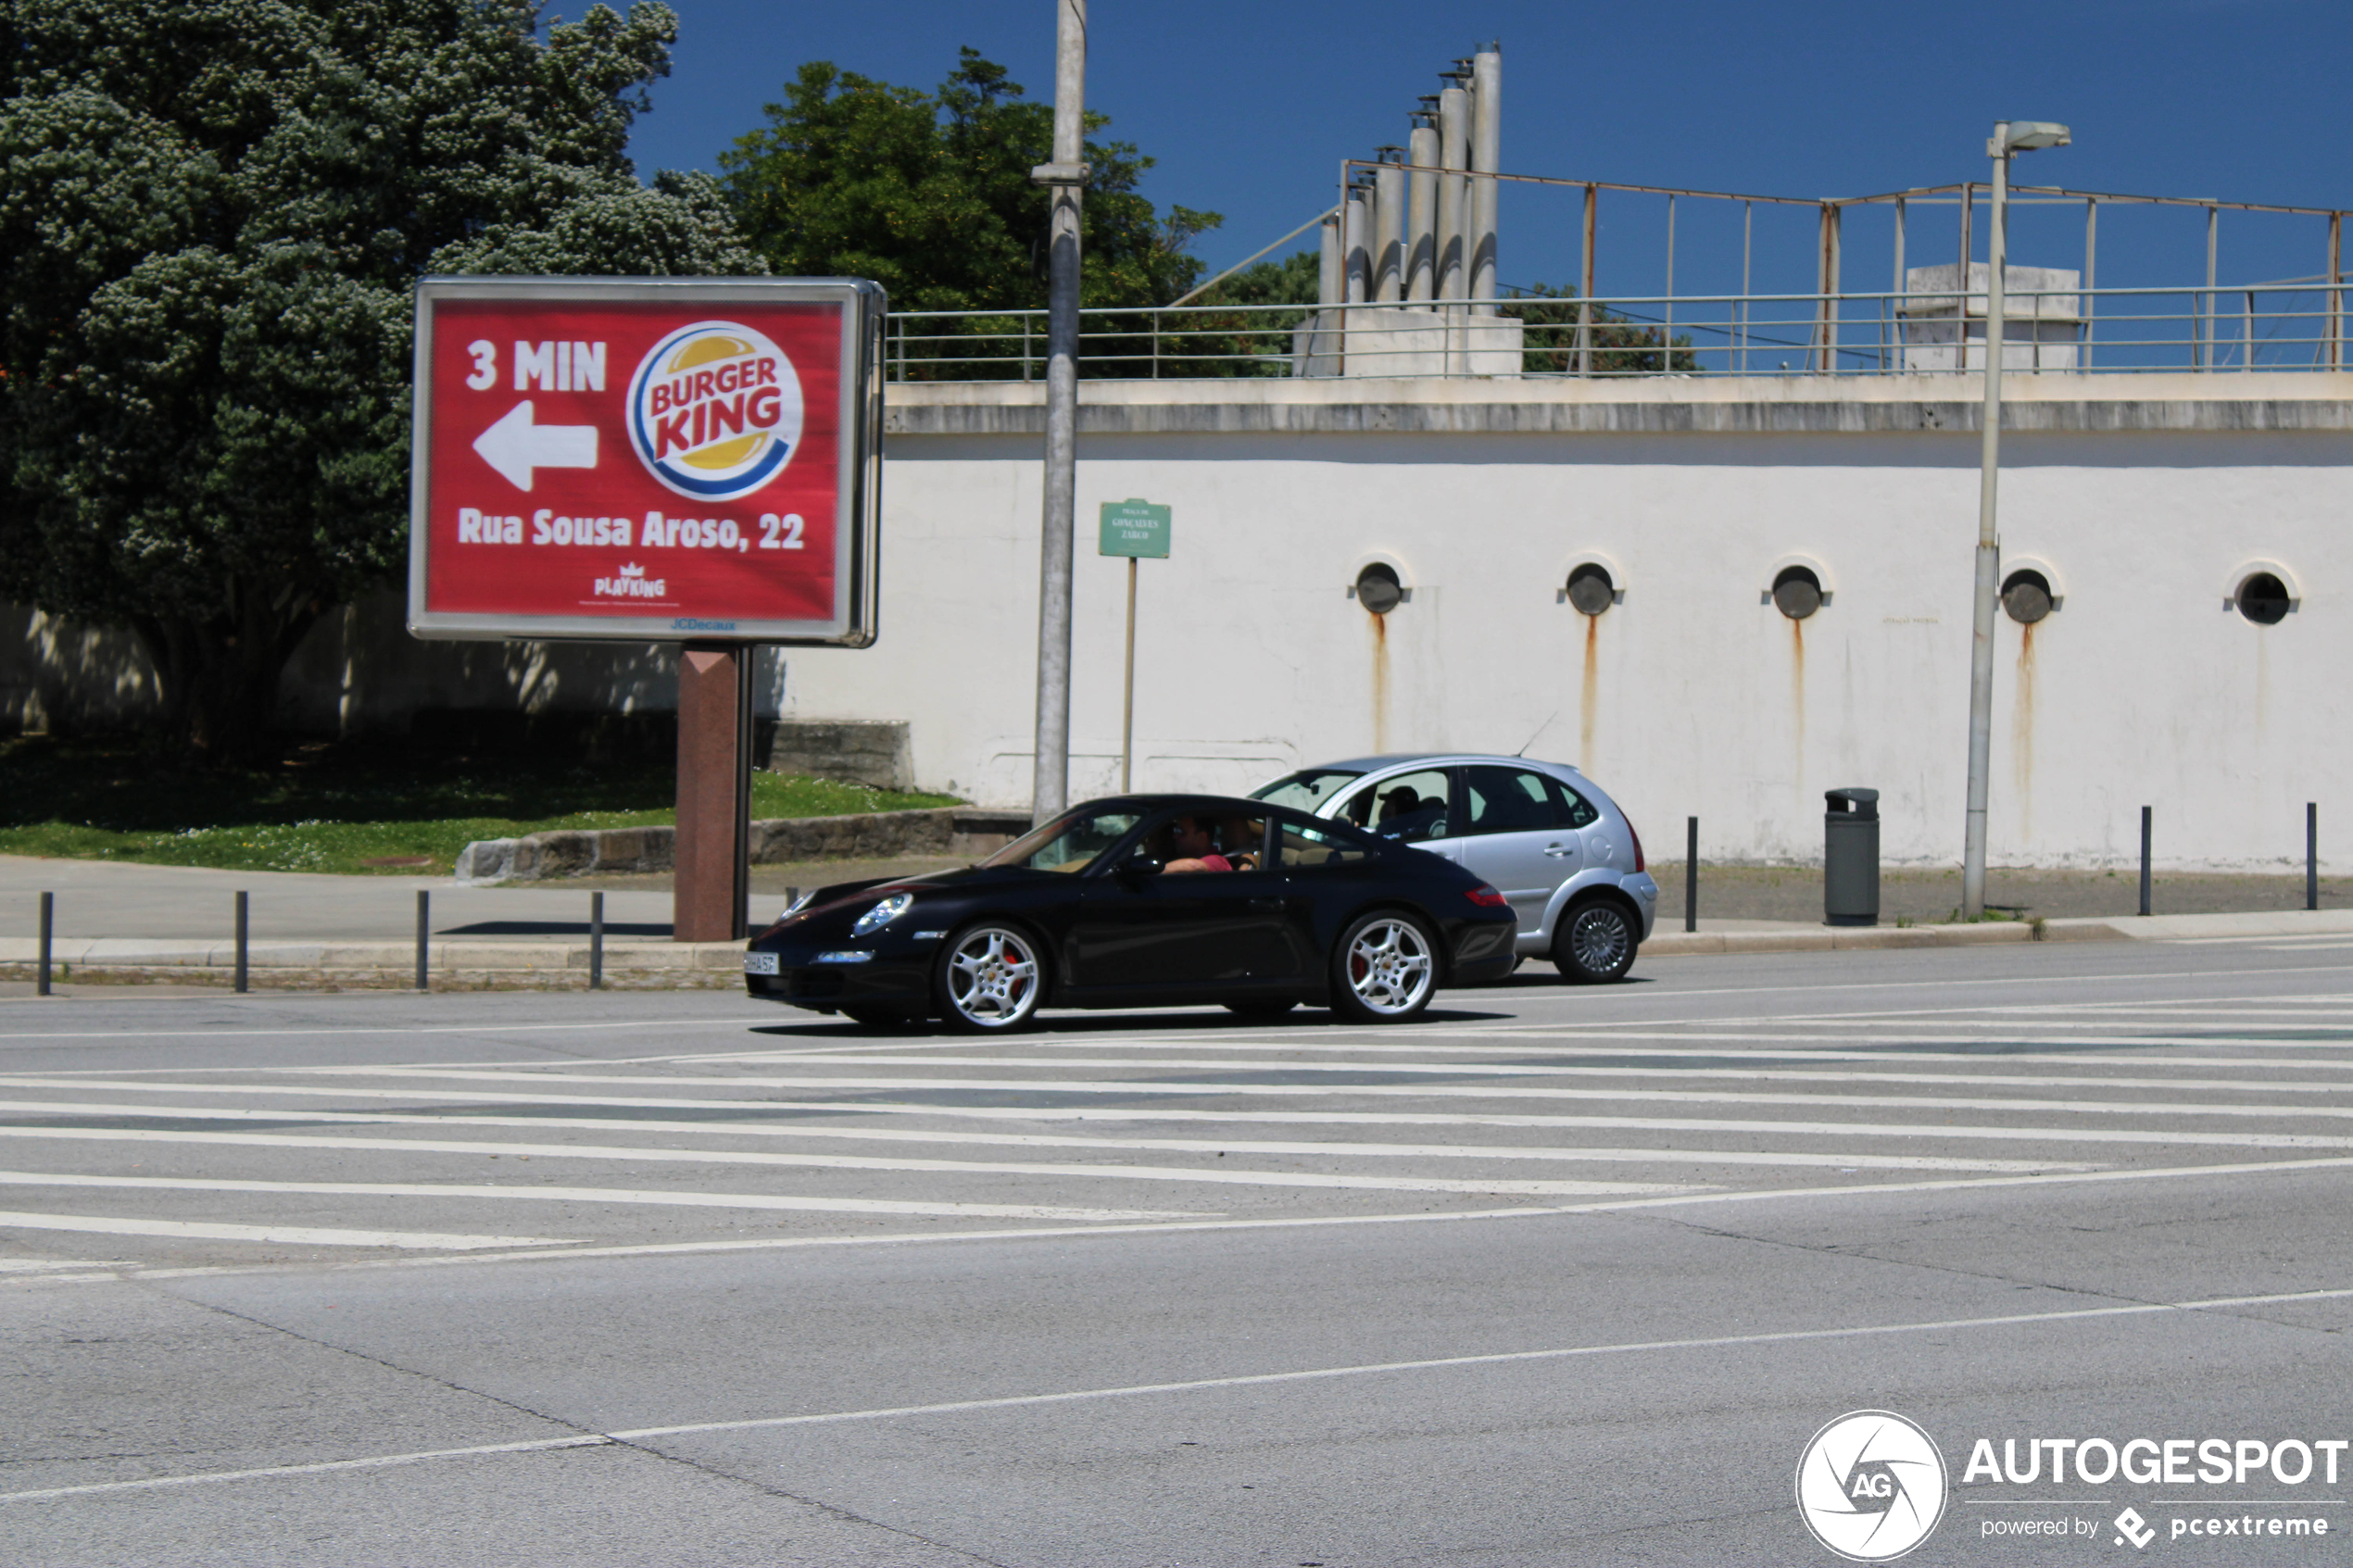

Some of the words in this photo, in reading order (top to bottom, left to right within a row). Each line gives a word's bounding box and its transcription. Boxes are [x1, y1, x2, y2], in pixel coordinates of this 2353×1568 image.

[466, 339, 497, 391] 3
[514, 340, 607, 392] MIN
[650, 357, 777, 418] BURGER
[655, 385, 782, 460] KING
[458, 507, 523, 545] Rua
[532, 508, 632, 547] Sousa
[640, 510, 749, 553] Aroso,
[758, 513, 805, 549] 22
[1112, 518, 1159, 529] GONÇALVES
[1121, 529, 1150, 539] ZARCO
[594, 577, 667, 598] PLAYKING
[671, 618, 736, 631] JCDecaux
